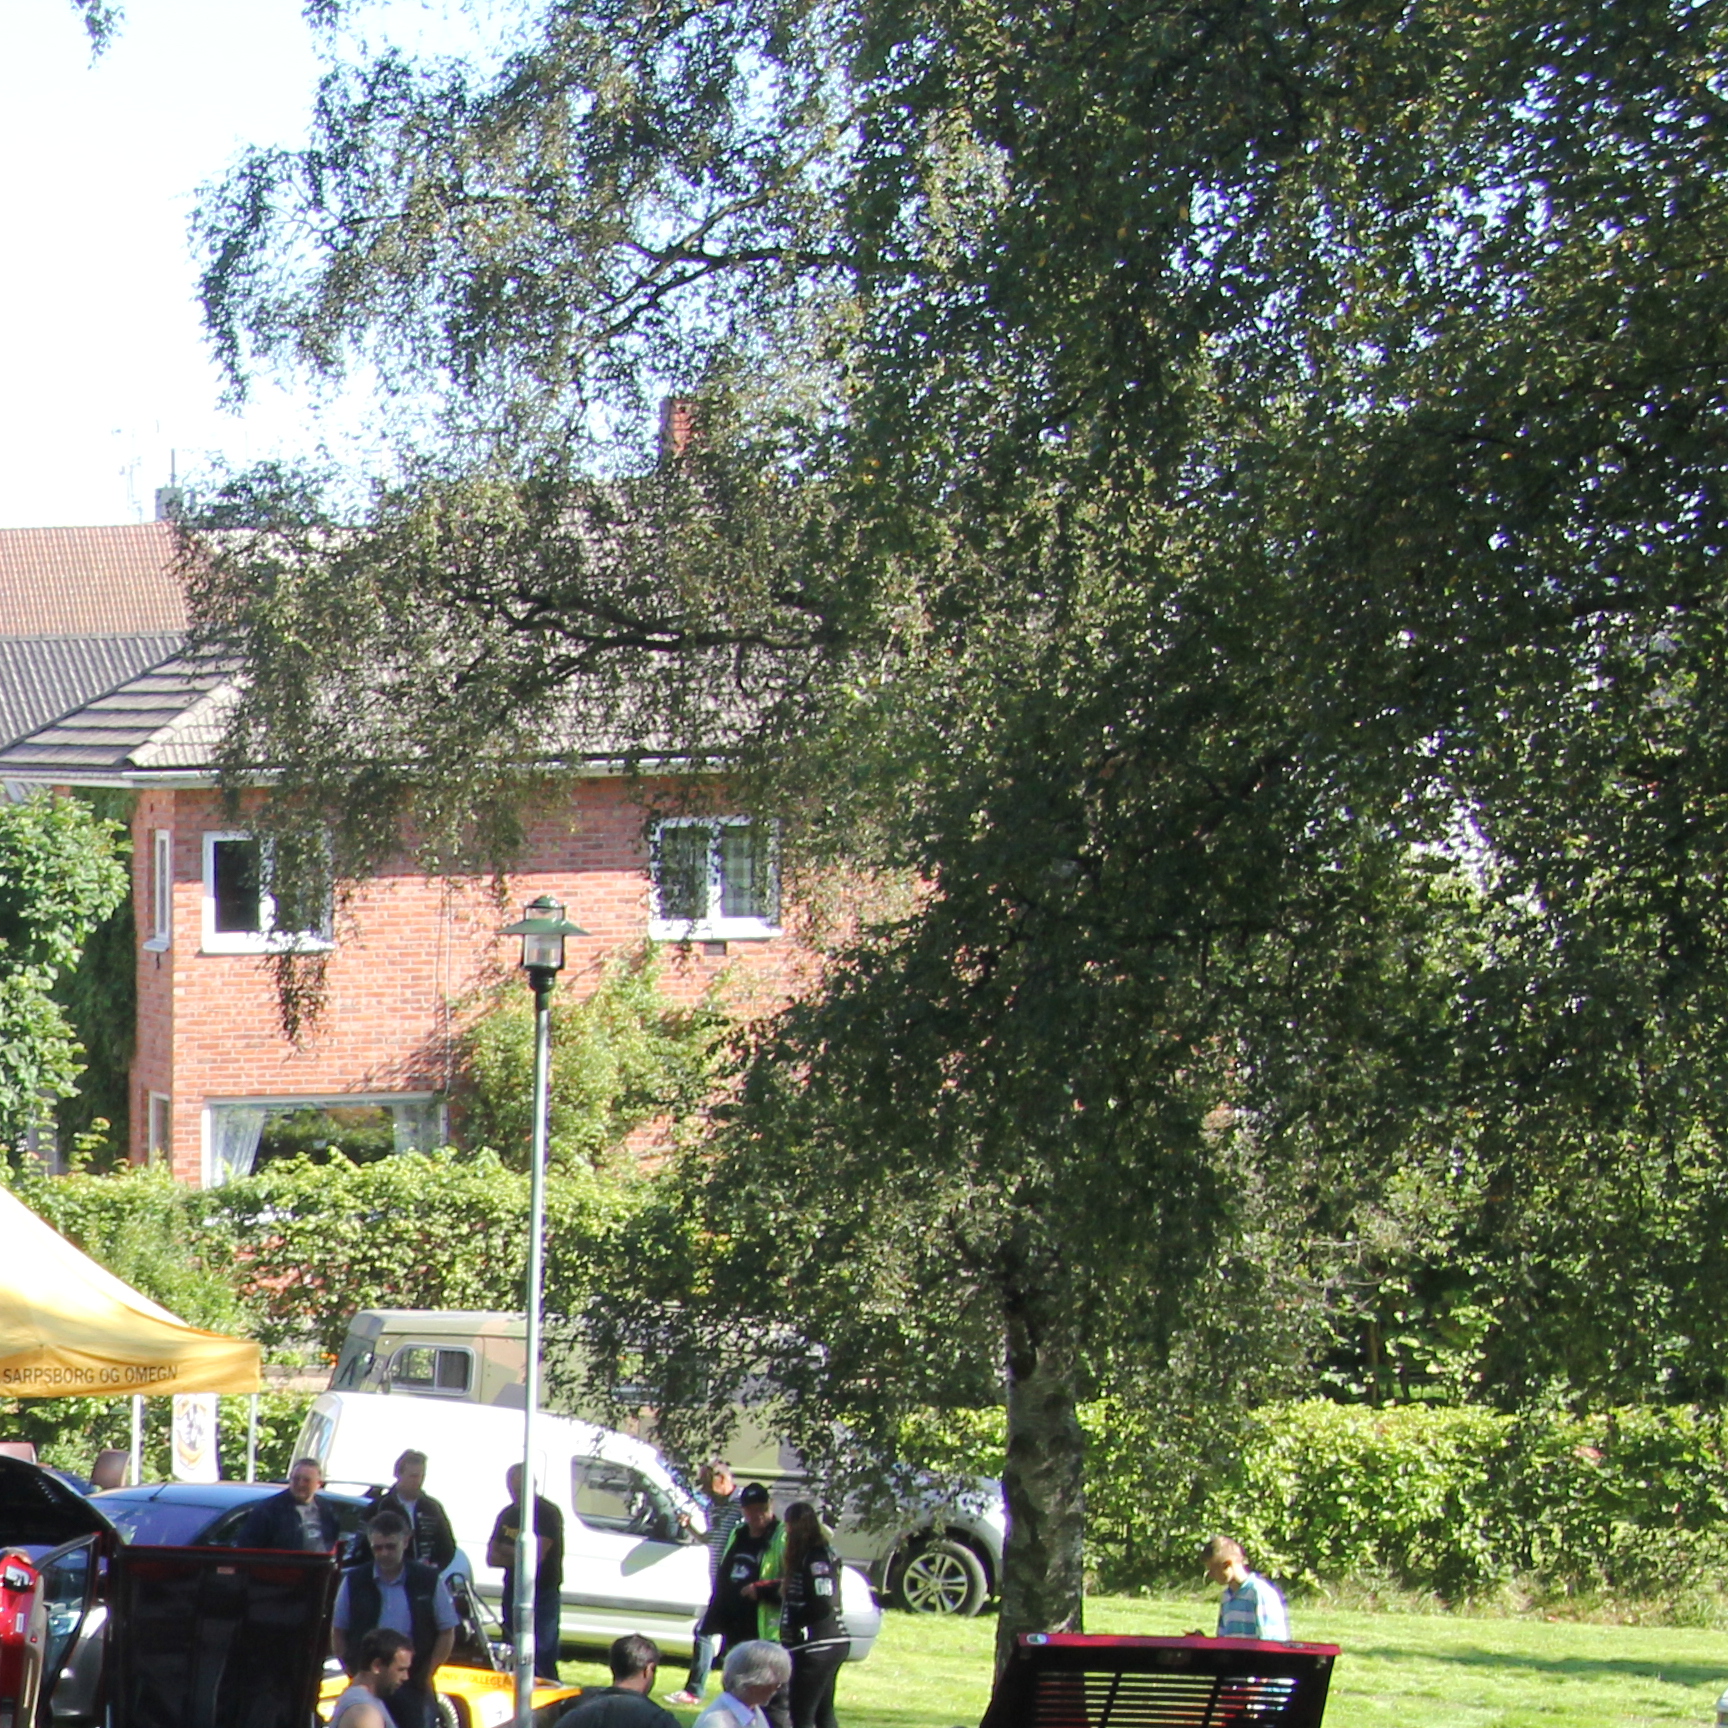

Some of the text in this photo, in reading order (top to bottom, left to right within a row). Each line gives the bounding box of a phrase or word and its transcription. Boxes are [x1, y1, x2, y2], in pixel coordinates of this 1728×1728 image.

[3, 1367, 94, 1384] SARPSBORG
[99, 1367, 120, 1382] OG
[125, 1365, 178, 1382] OMEGN
